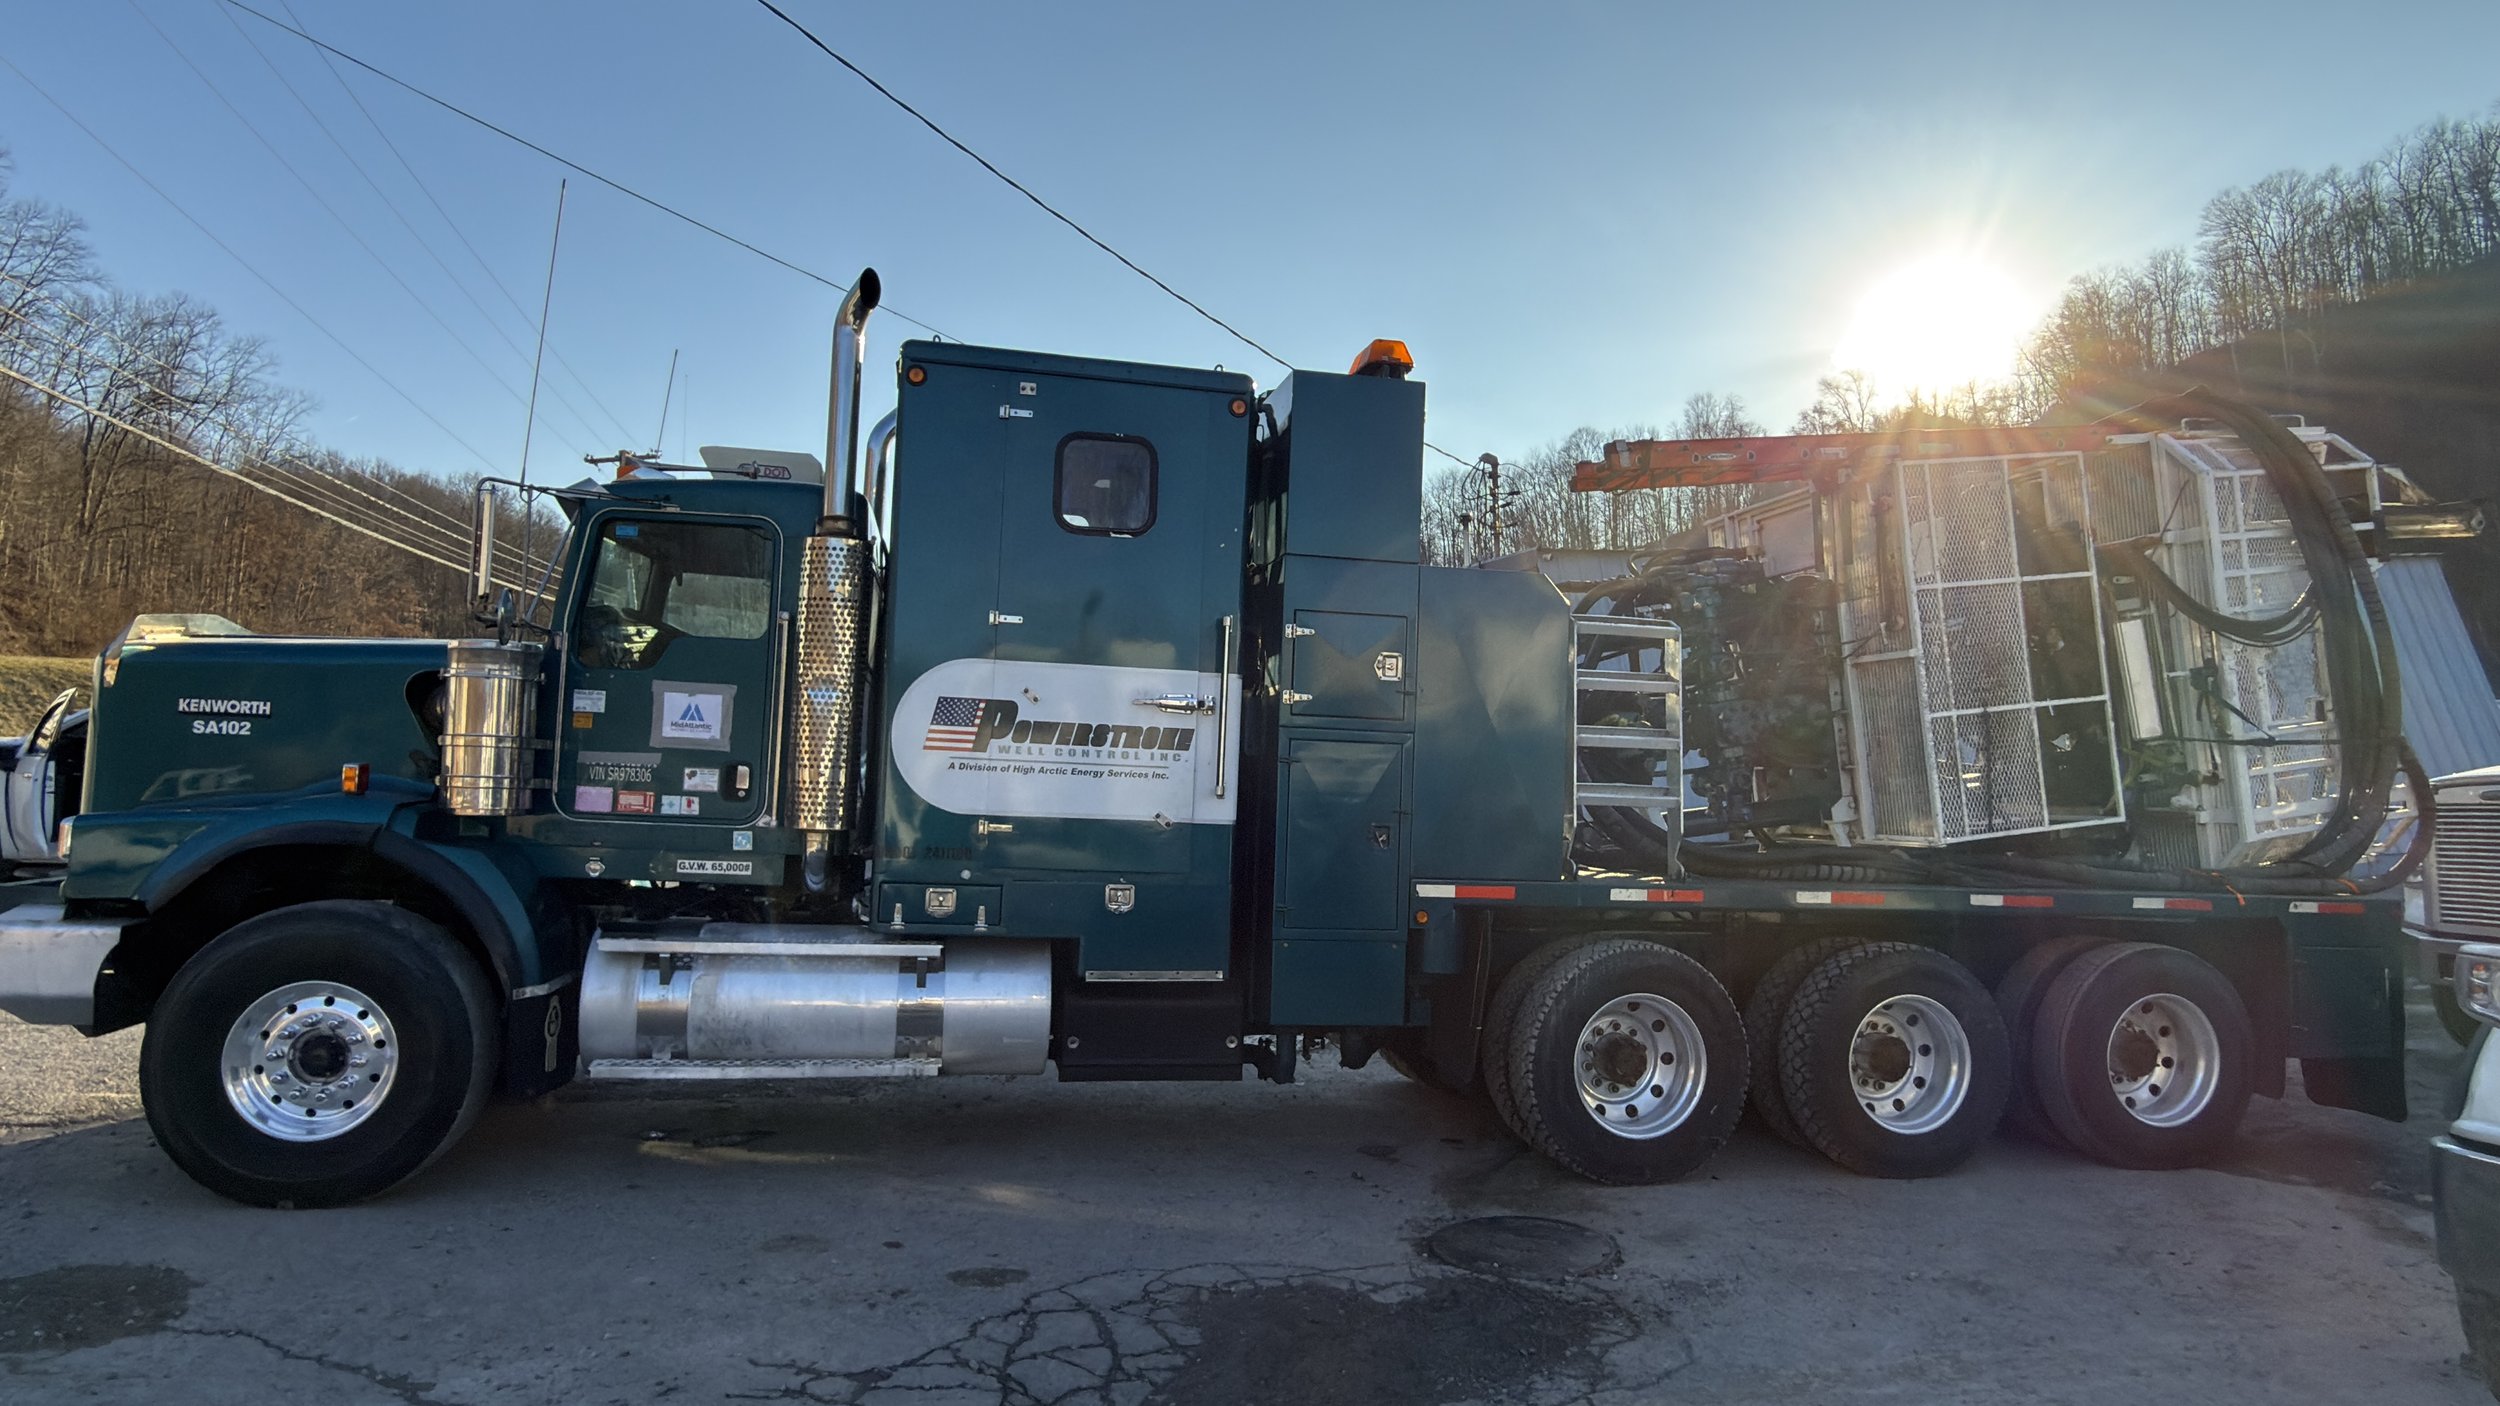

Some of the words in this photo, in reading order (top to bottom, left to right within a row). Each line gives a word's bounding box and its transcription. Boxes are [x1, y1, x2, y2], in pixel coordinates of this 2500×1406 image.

[178, 698, 271, 715] KENWORTH
[192, 719, 252, 735] SA102
[670, 720, 713, 731] MidAtlantic
[972, 698, 1196, 753] POWERSTROKE
[997, 744, 1046, 756] WELL
[1054, 747, 1141, 760] CONTROL
[1150, 751, 1189, 763] INC.
[589, 766, 606, 780] VIN
[947, 761, 956, 771] A
[958, 762, 998, 773] Division
[999, 764, 1011, 774] of
[1013, 765, 1036, 776] High
[1038, 766, 1068, 776] Arctic
[1070, 767, 1105, 779] Energy
[1107, 769, 1149, 780] Services
[1151, 771, 1170, 781] Inc.
[678, 861, 709, 872] G.V.W.
[711, 862, 752, 874] 65,000#
